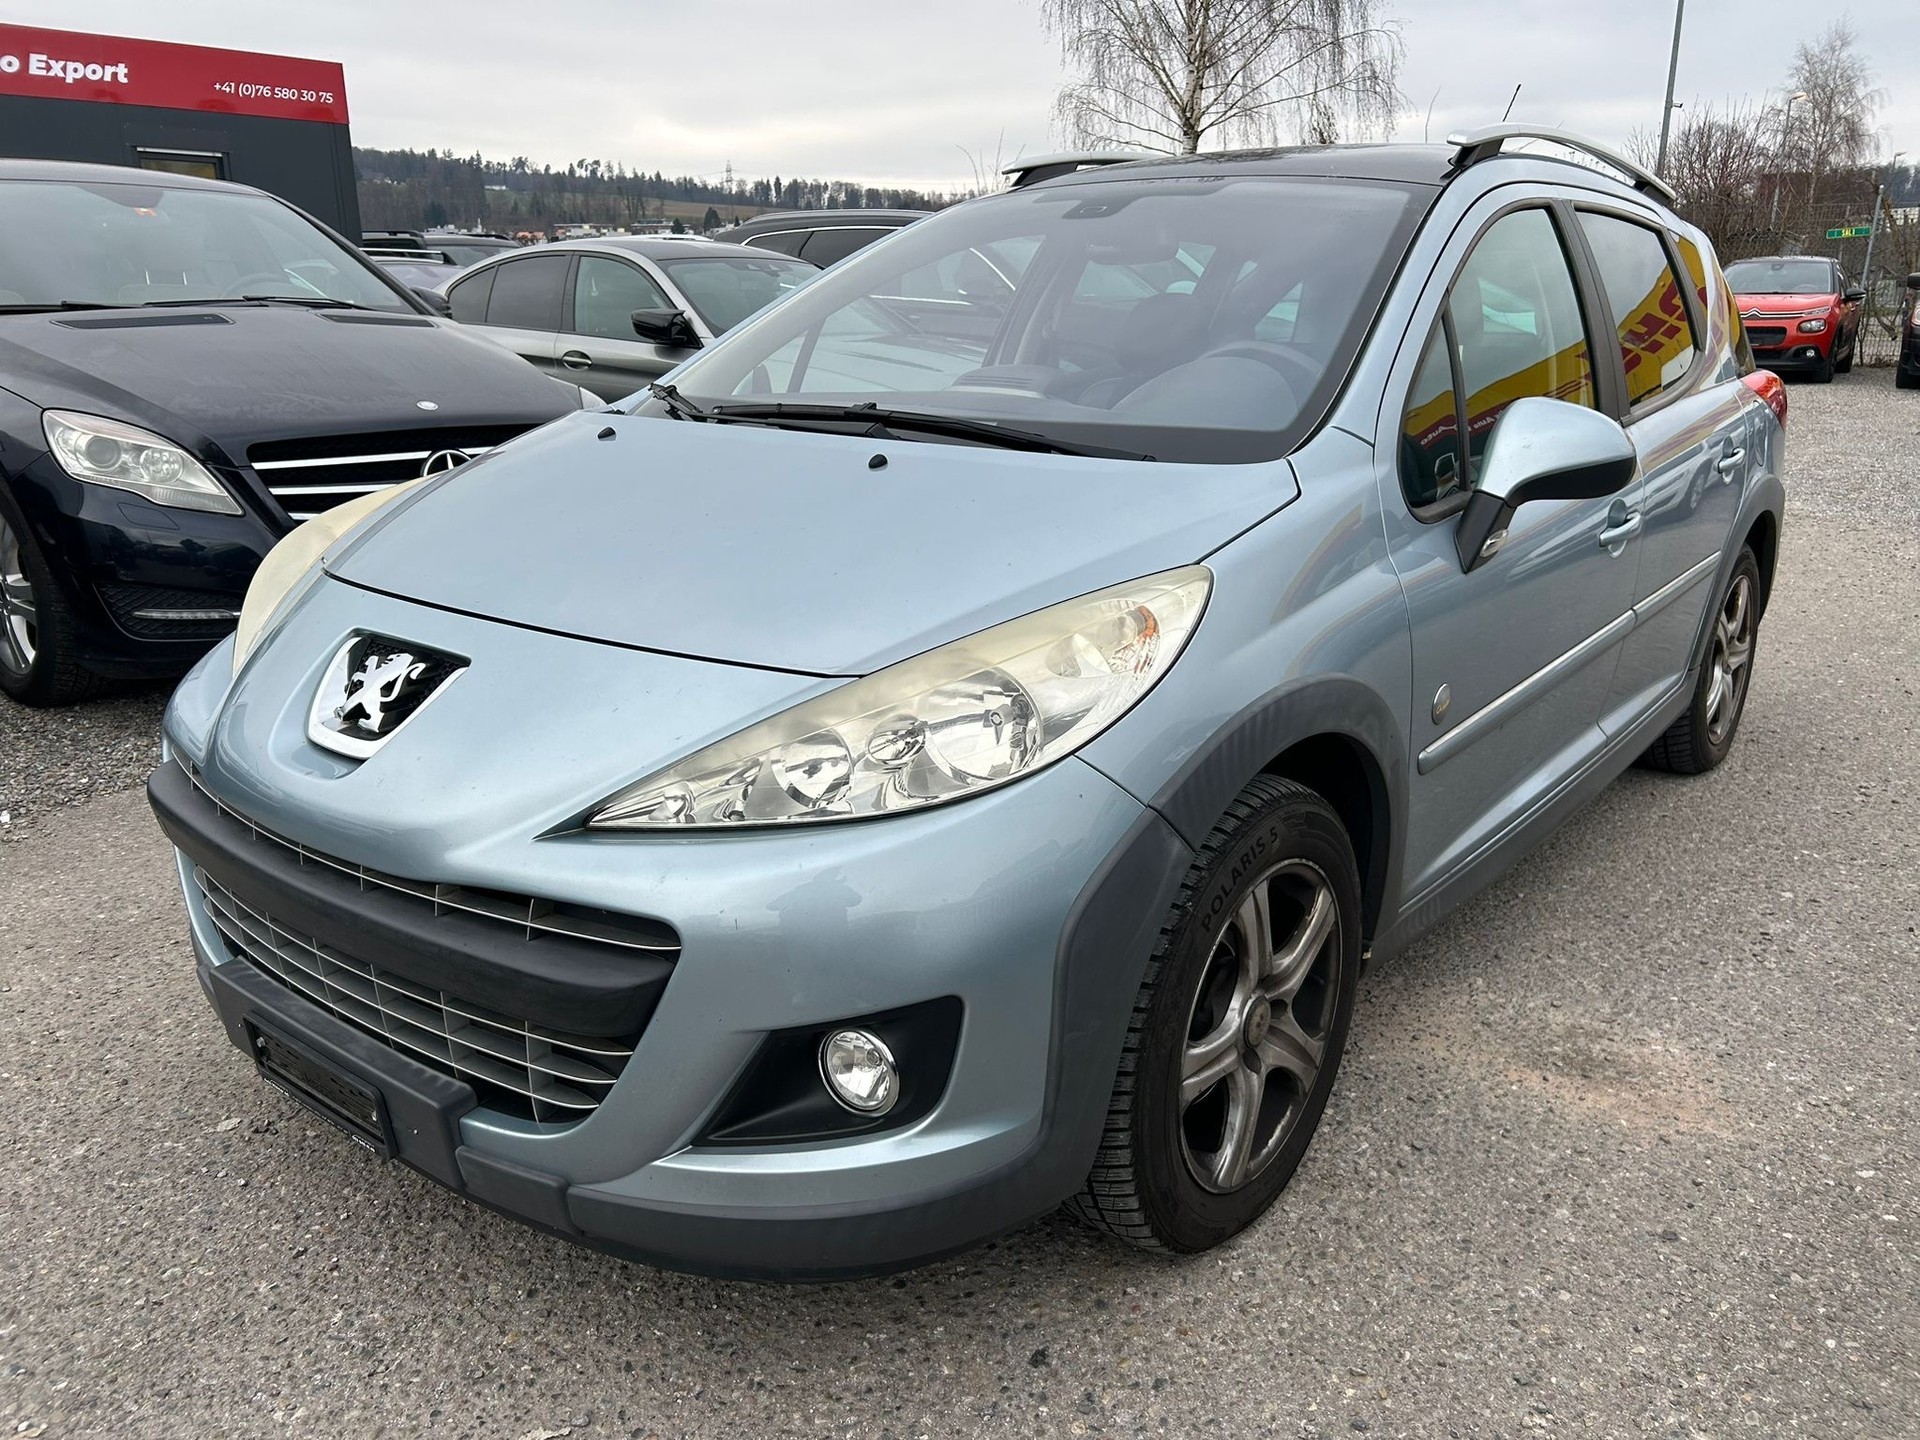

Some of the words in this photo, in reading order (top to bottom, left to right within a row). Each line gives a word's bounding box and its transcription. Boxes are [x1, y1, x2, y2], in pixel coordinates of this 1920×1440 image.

[0, 55, 20, 73] o
[29, 53, 128, 83] Export
[214, 82, 235, 94] +41
[239, 83, 271, 98] (0)76
[274, 87, 298, 100] 580
[300, 90, 316, 102] 30
[319, 92, 334, 104] 75
[1201, 837, 1266, 932] POLARIS
[1270, 826, 1278, 844] 5
